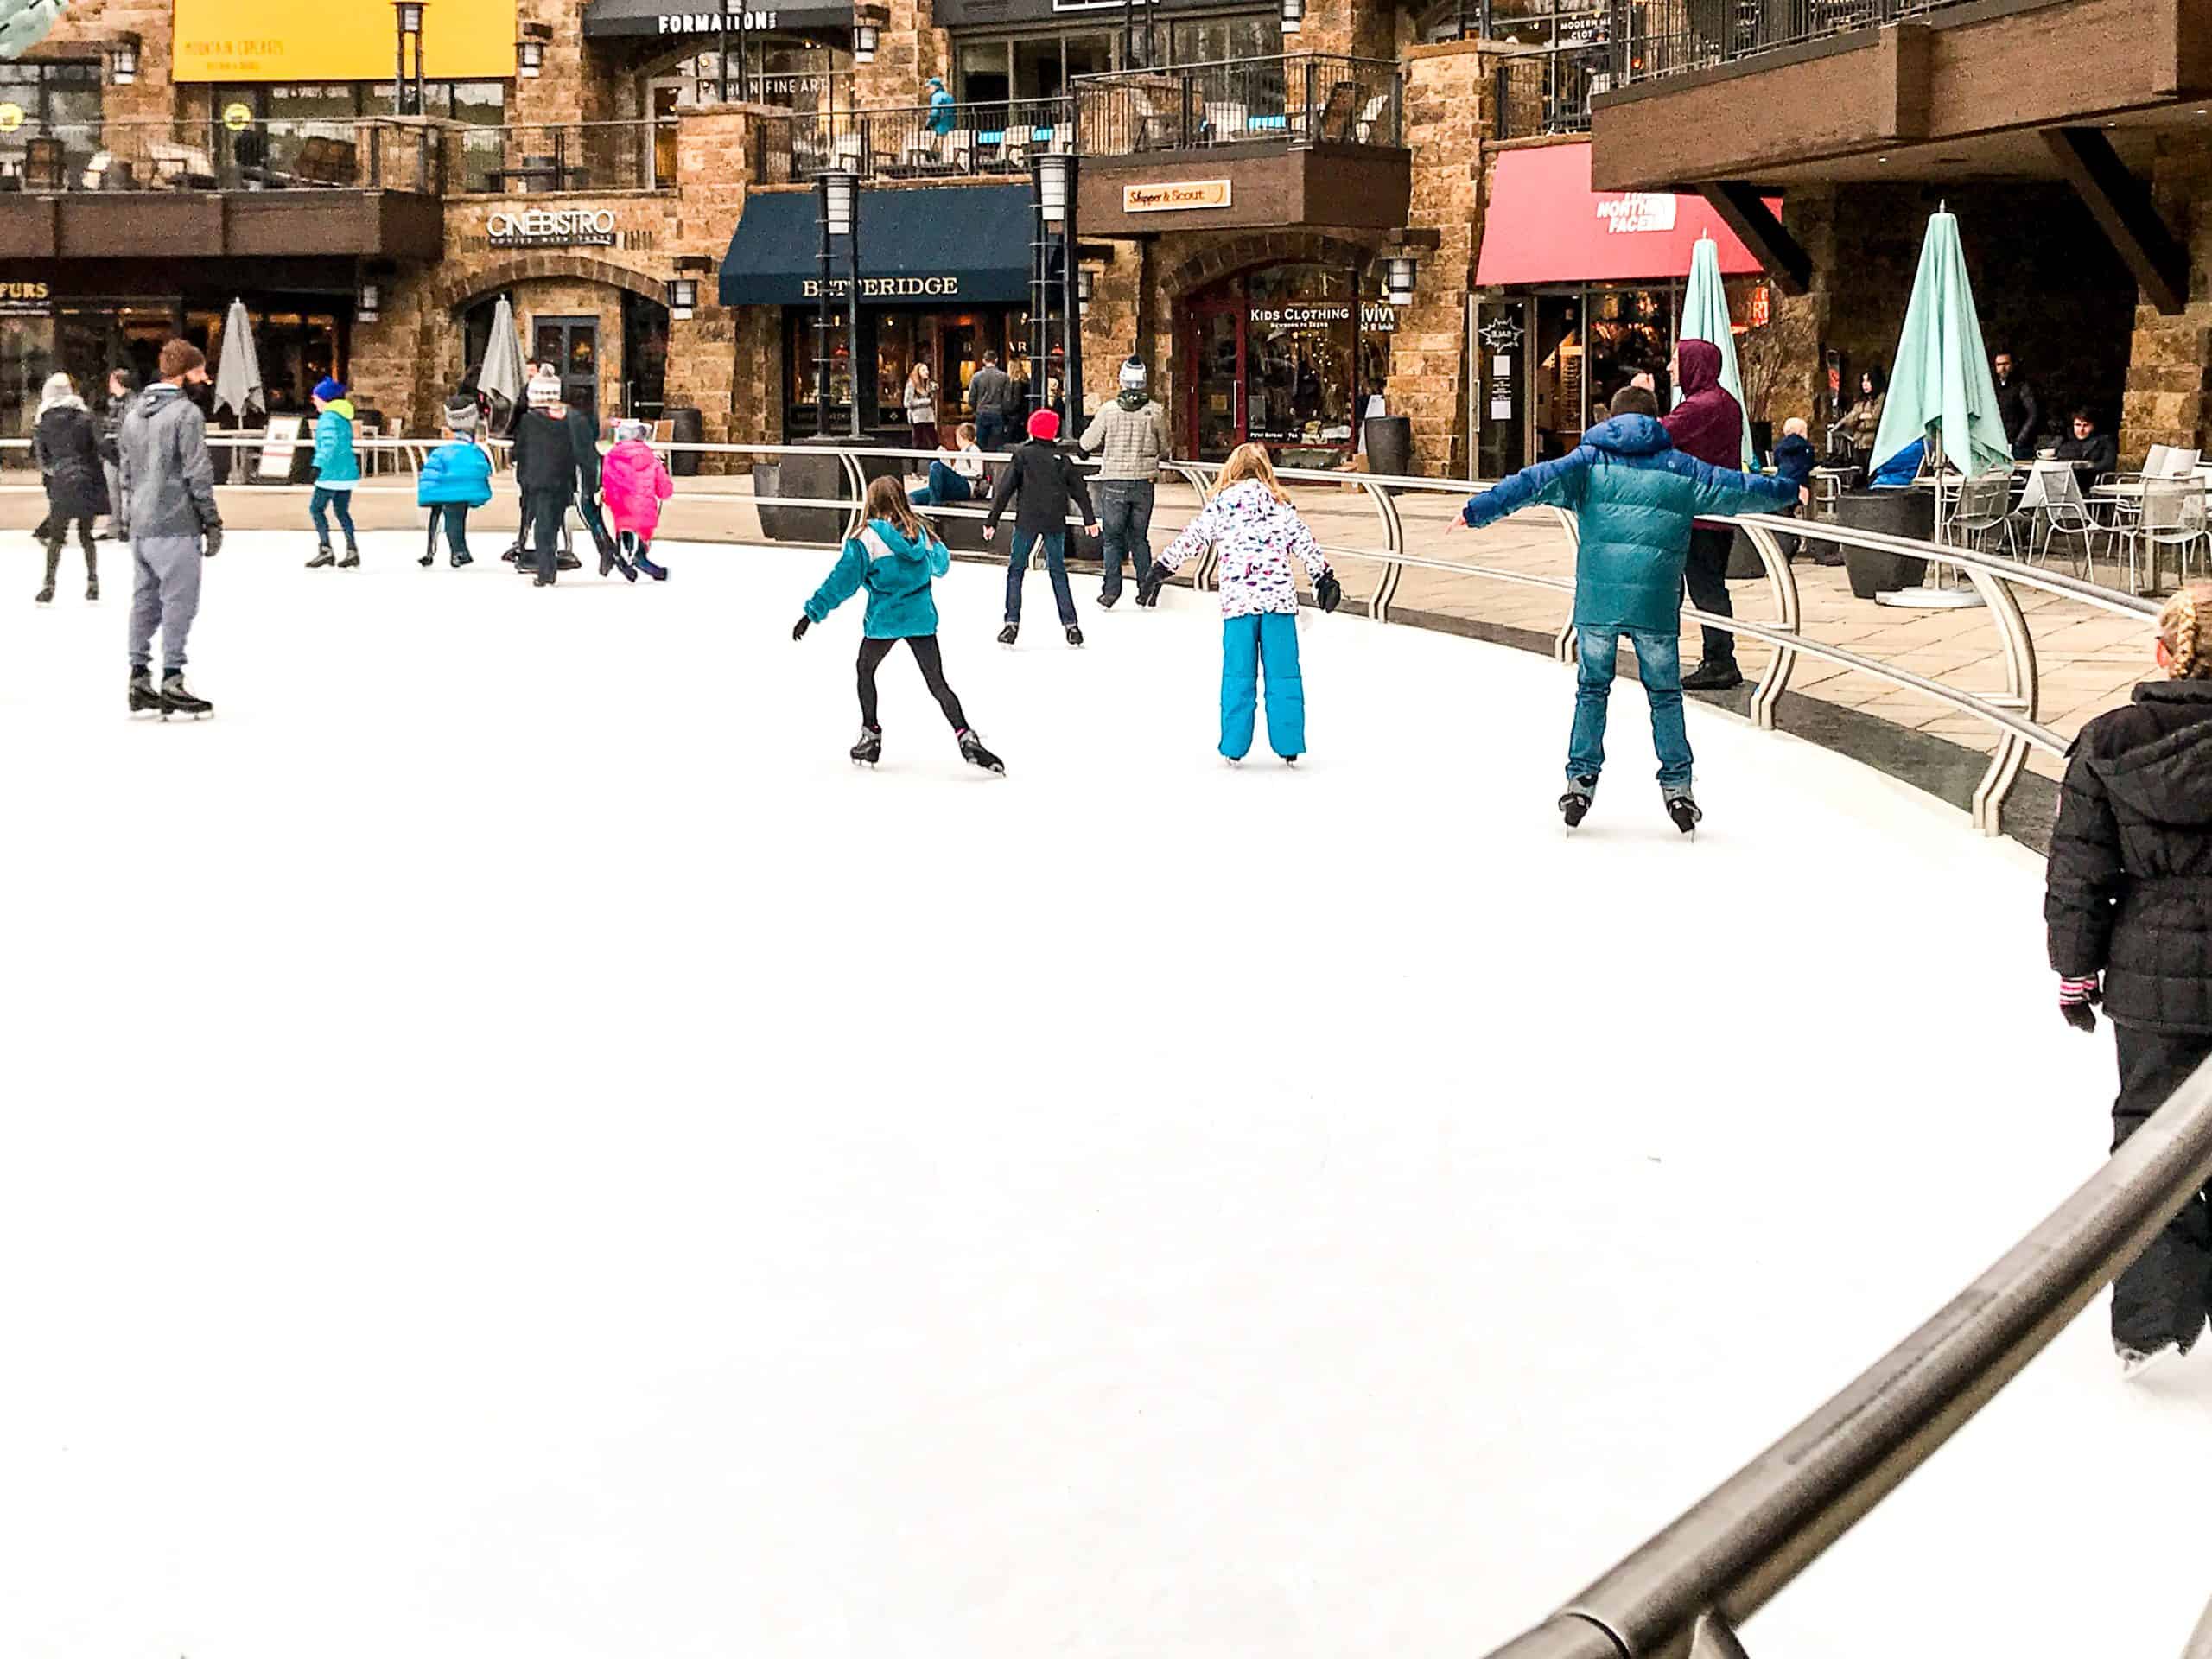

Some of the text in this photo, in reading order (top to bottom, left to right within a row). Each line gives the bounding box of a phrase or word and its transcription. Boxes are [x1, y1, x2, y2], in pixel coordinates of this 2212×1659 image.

[766, 79, 795, 94] FINE
[1163, 191, 1170, 202] &
[1172, 189, 1205, 201] Scout
[1596, 200, 1647, 219] NORTH
[1608, 215, 1649, 233] FACE
[803, 277, 958, 297] BTERIDGE
[1250, 308, 1350, 321] KIDS CLOTHING
